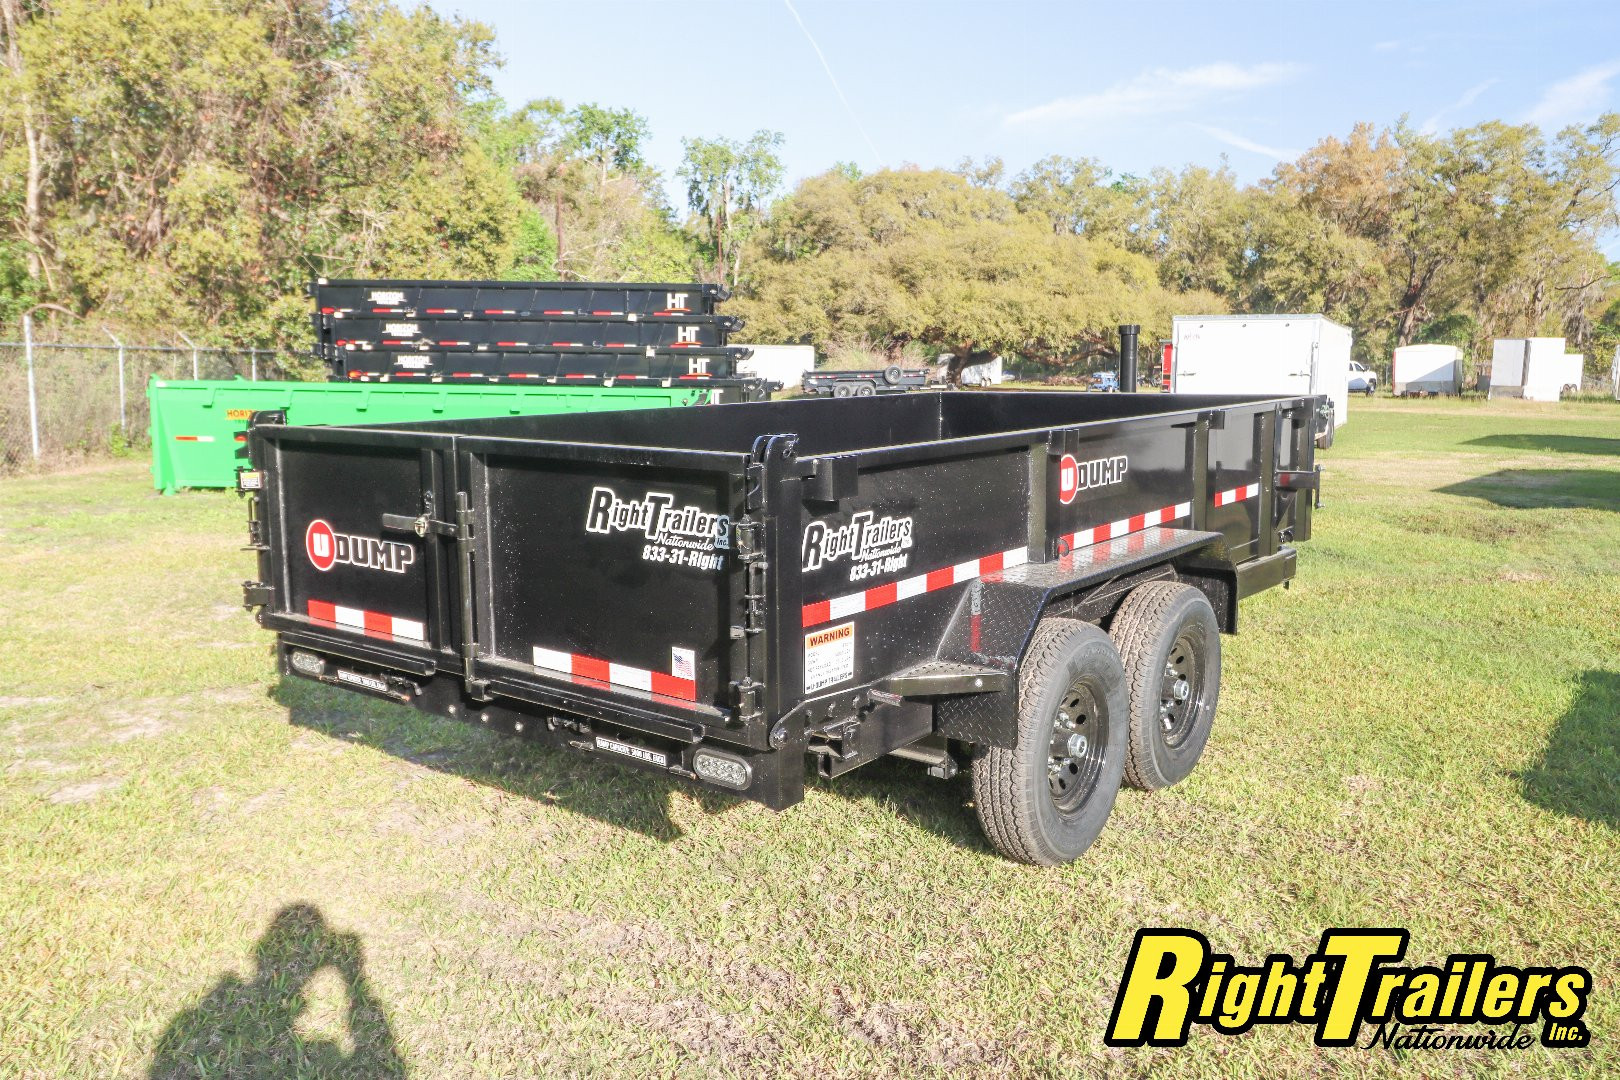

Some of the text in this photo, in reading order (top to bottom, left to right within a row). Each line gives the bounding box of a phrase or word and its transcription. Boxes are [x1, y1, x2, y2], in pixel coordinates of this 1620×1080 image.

[666, 293, 688, 309] HT
[677, 326, 700, 343] HT
[688, 358, 710, 374] HT
[654, 532, 714, 550] Nationwide
[810, 627, 850, 647] WARNING
